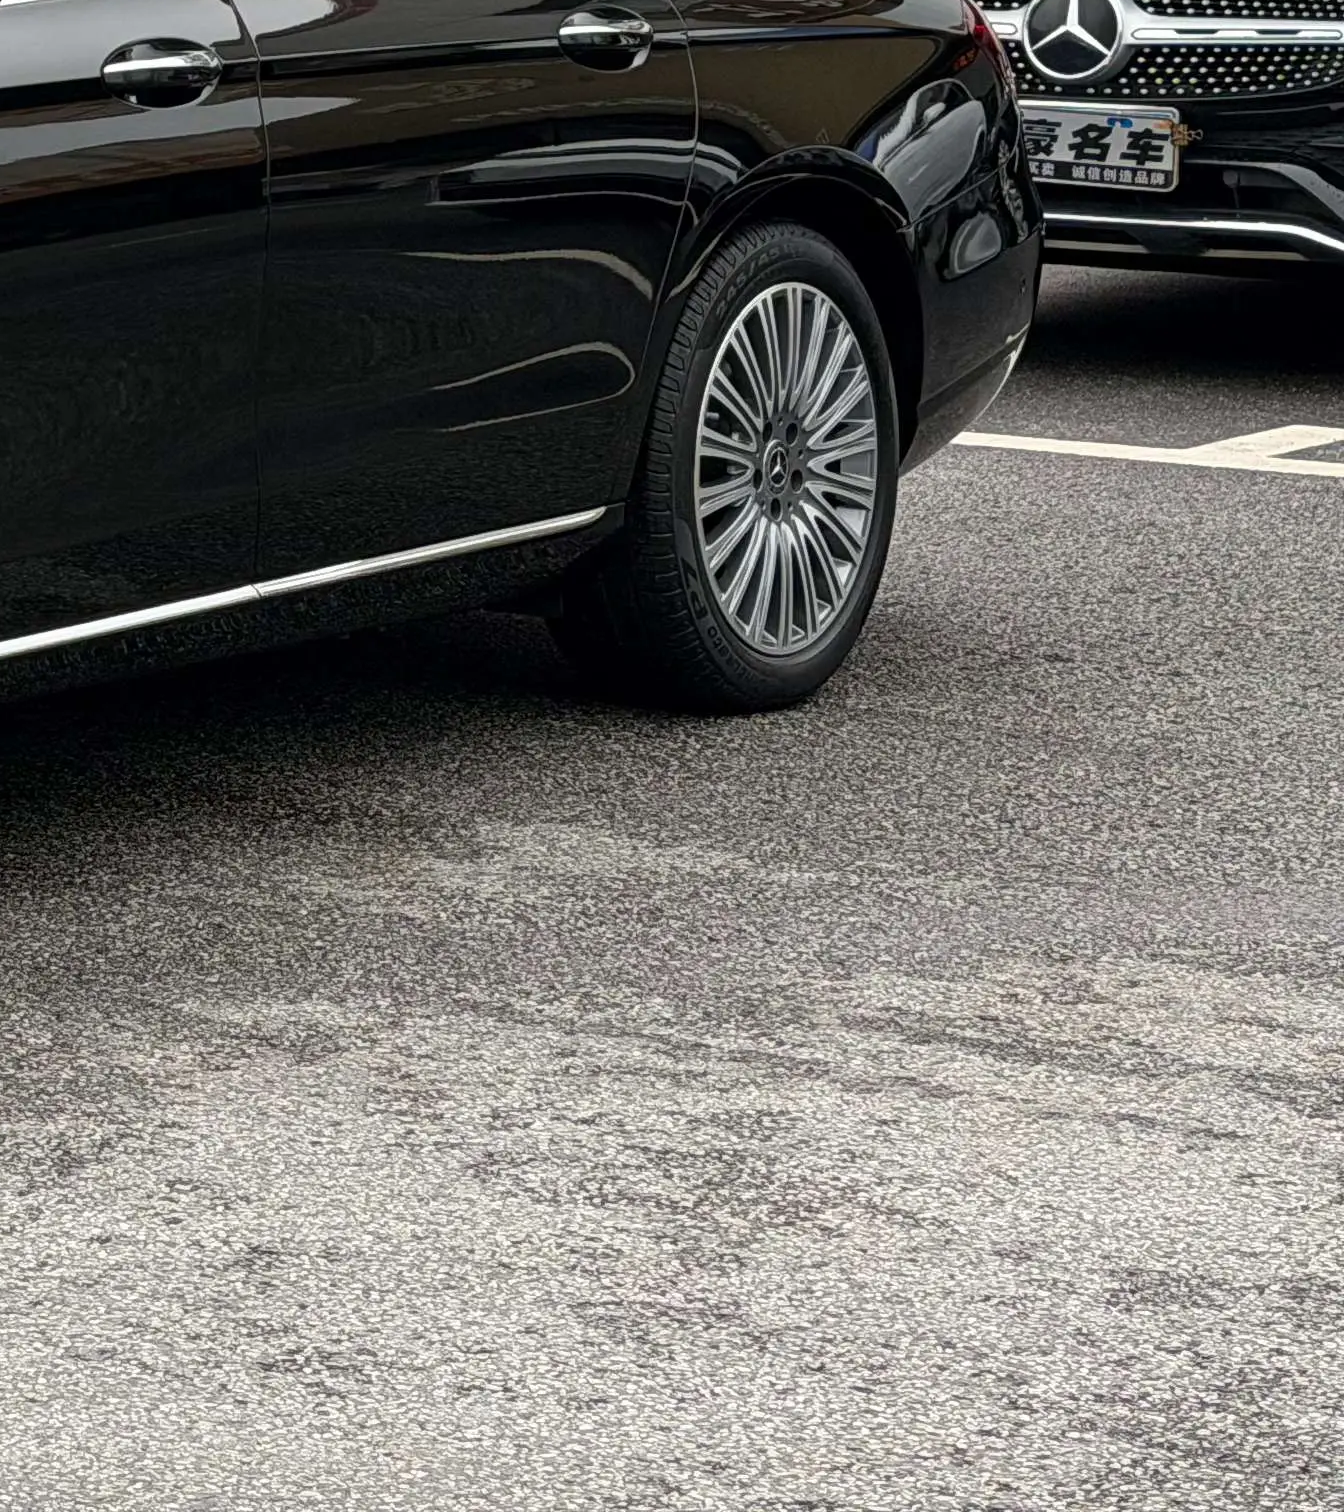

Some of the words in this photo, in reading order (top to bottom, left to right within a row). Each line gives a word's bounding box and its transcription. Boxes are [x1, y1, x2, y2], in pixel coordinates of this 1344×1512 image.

[1071, 164, 1165, 186] 诚信创造品牌
